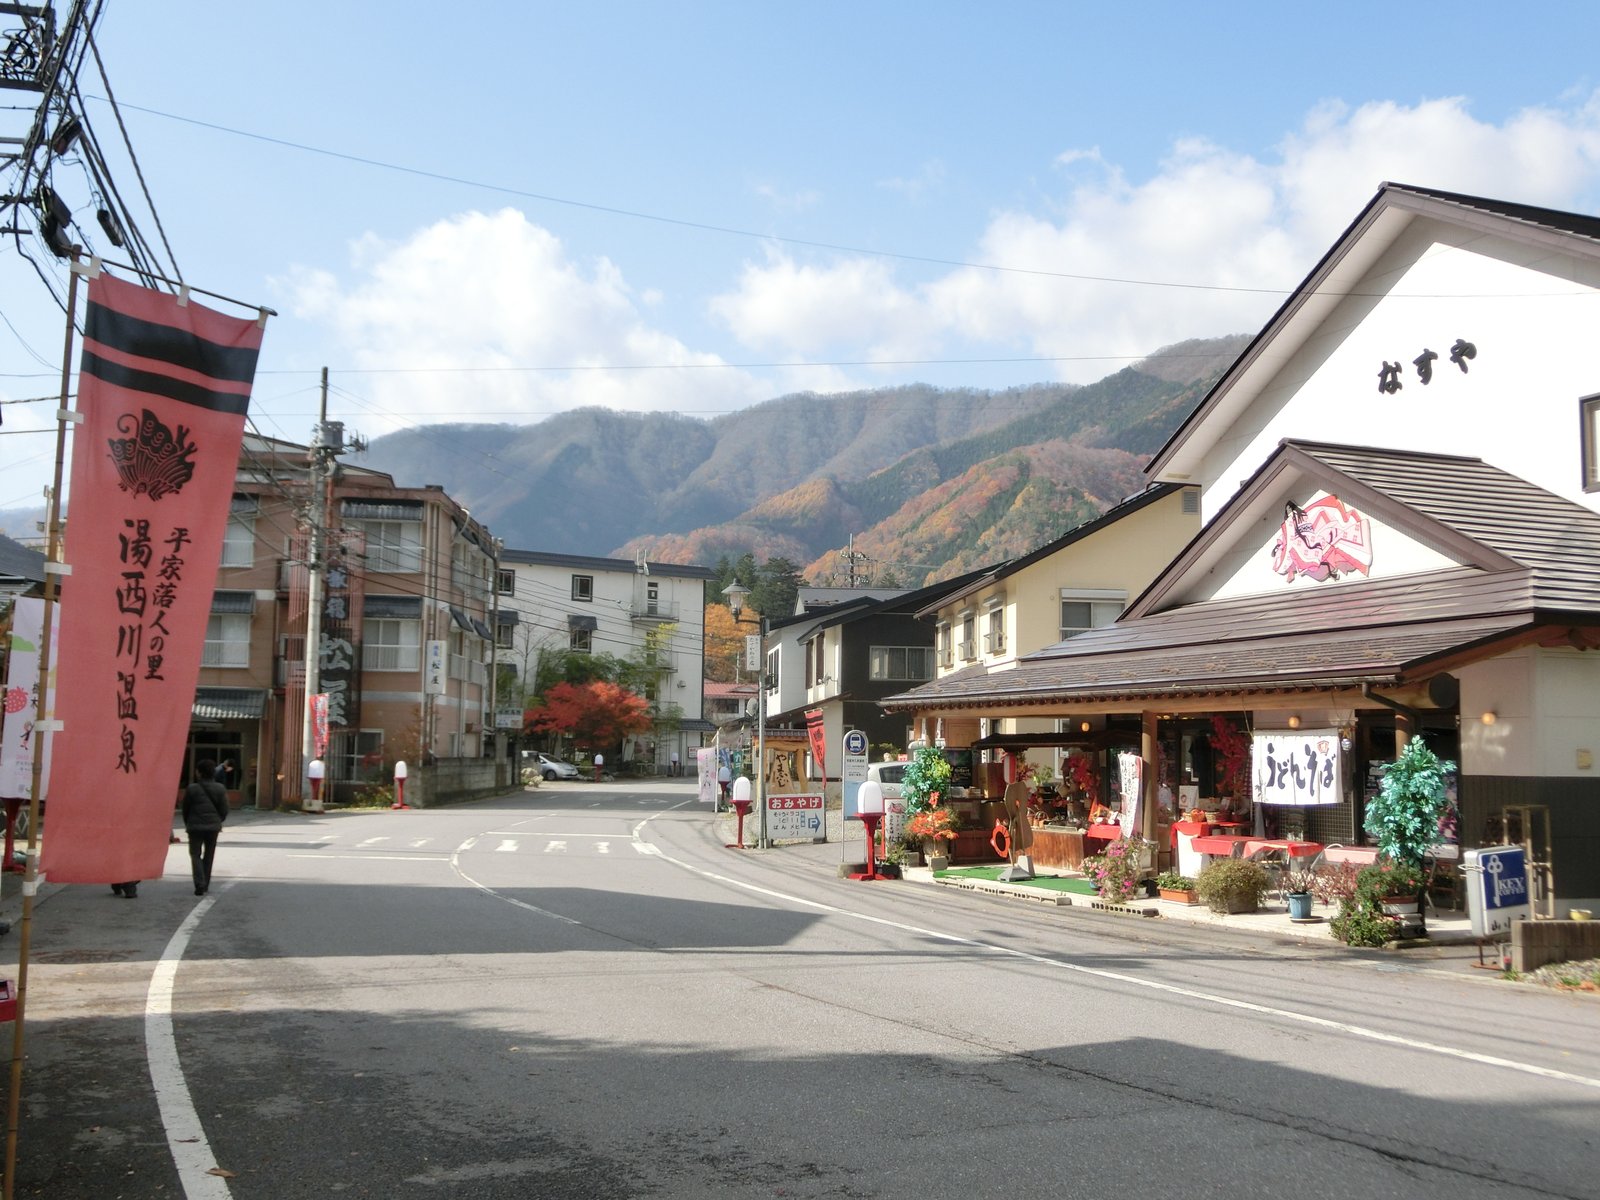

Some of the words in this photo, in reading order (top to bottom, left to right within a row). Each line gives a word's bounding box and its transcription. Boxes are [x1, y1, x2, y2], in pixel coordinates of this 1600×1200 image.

[1378, 338, 1477, 395] なすや
[144, 527, 191, 681] 平家落人の里
[116, 518, 153, 773] 湯西川温泉
[771, 798, 820, 809] おみやげ
[1499, 877, 1525, 889] KEY
